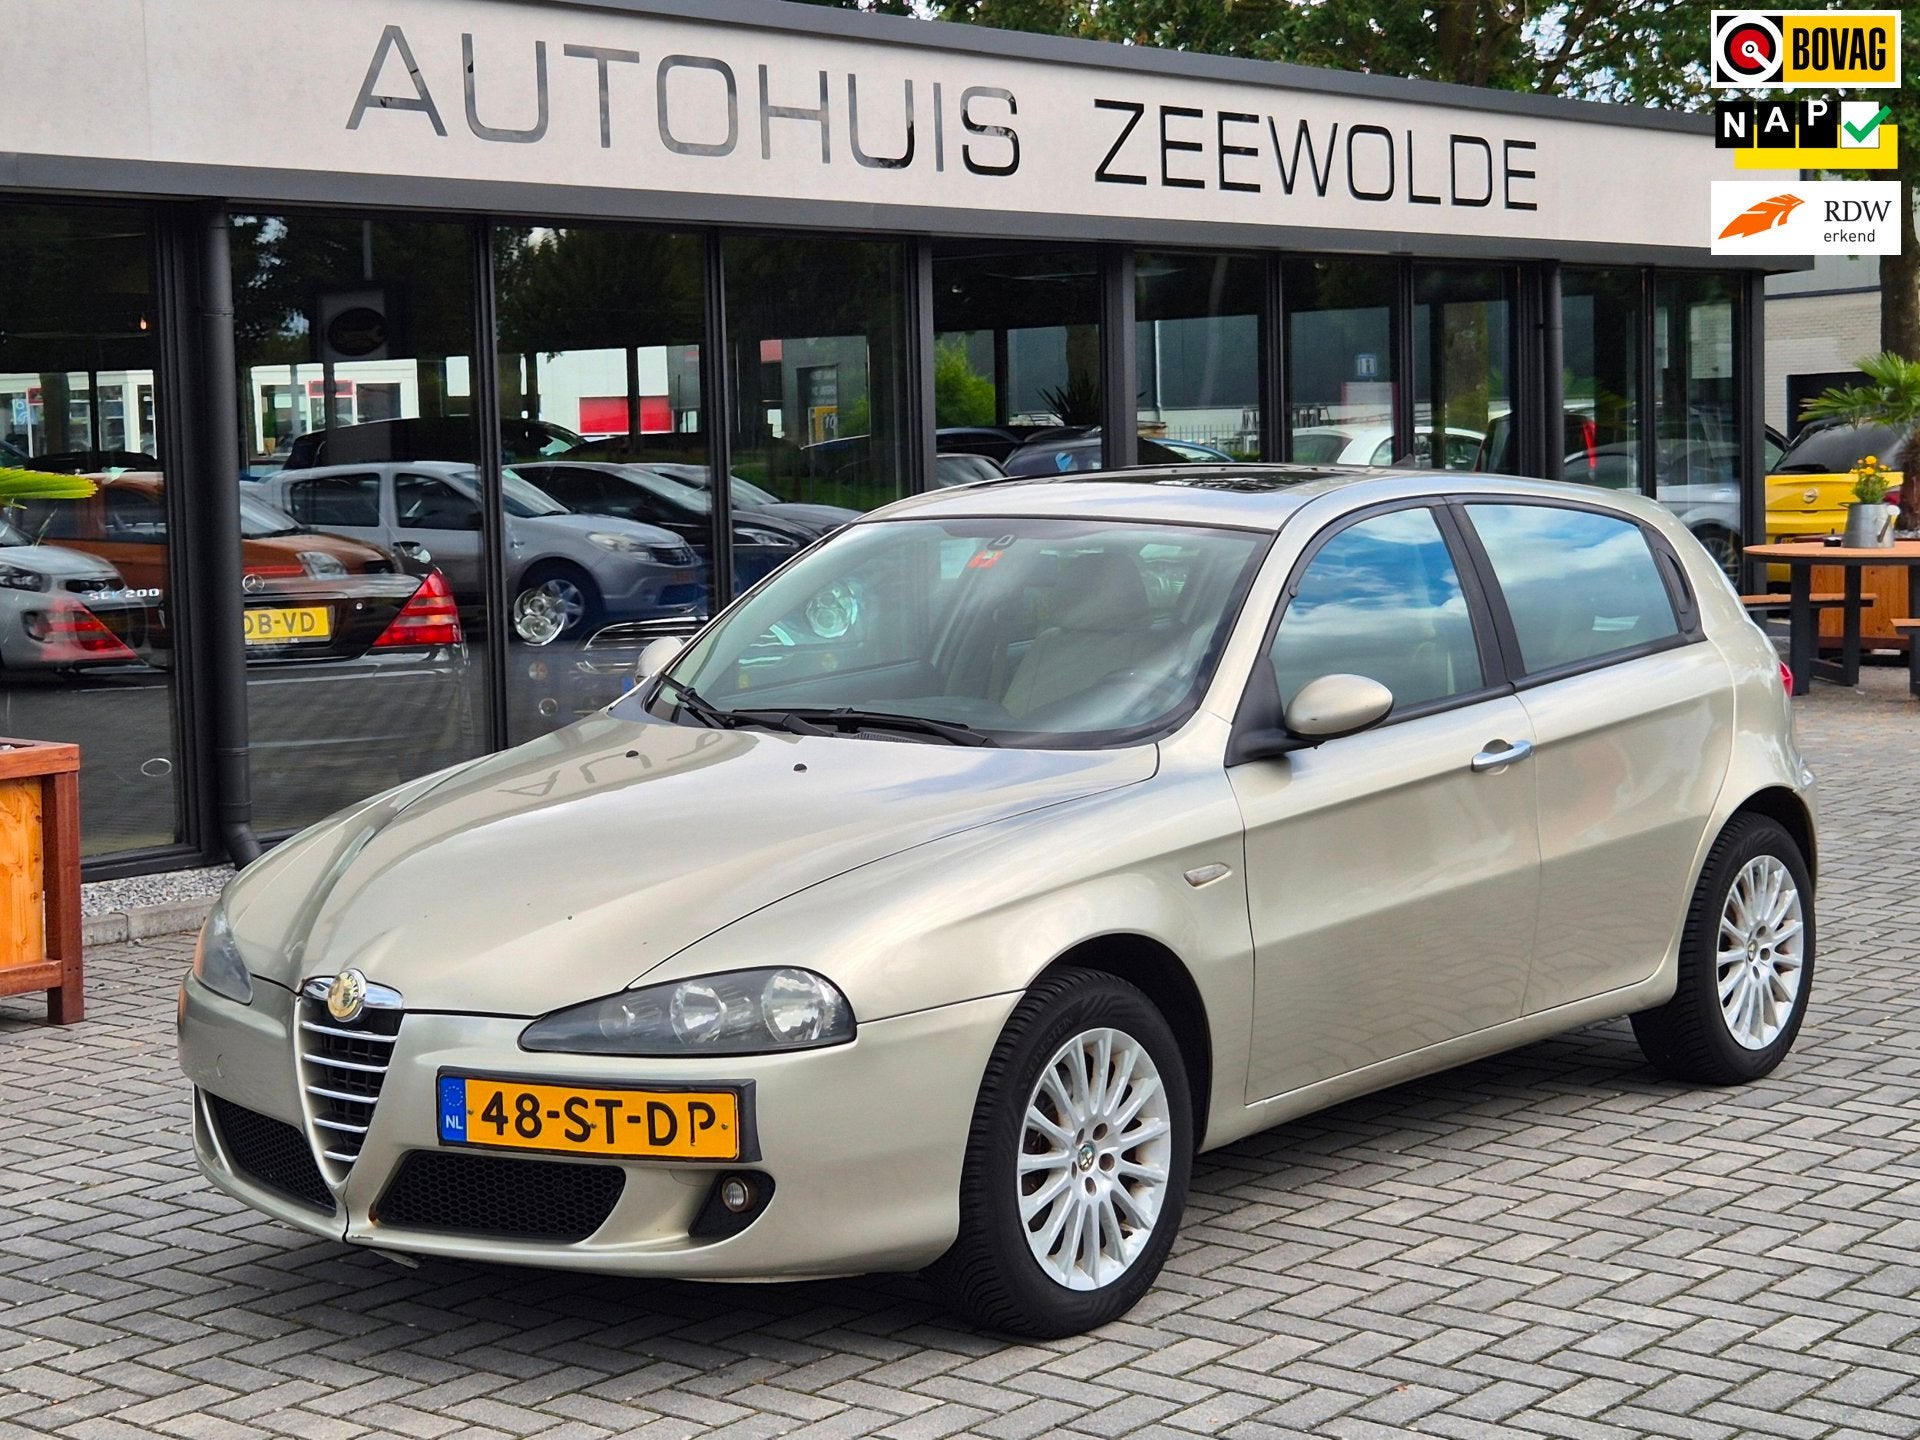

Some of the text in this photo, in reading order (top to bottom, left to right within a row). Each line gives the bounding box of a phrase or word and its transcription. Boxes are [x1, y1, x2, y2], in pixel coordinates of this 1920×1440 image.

[346, 24, 1537, 211] AUTOHUIS ZEEWOLDE
[125, 588, 160, 598] 200
[445, 1113, 464, 1131] NL
[481, 1090, 716, 1147] 48-ST-DP
